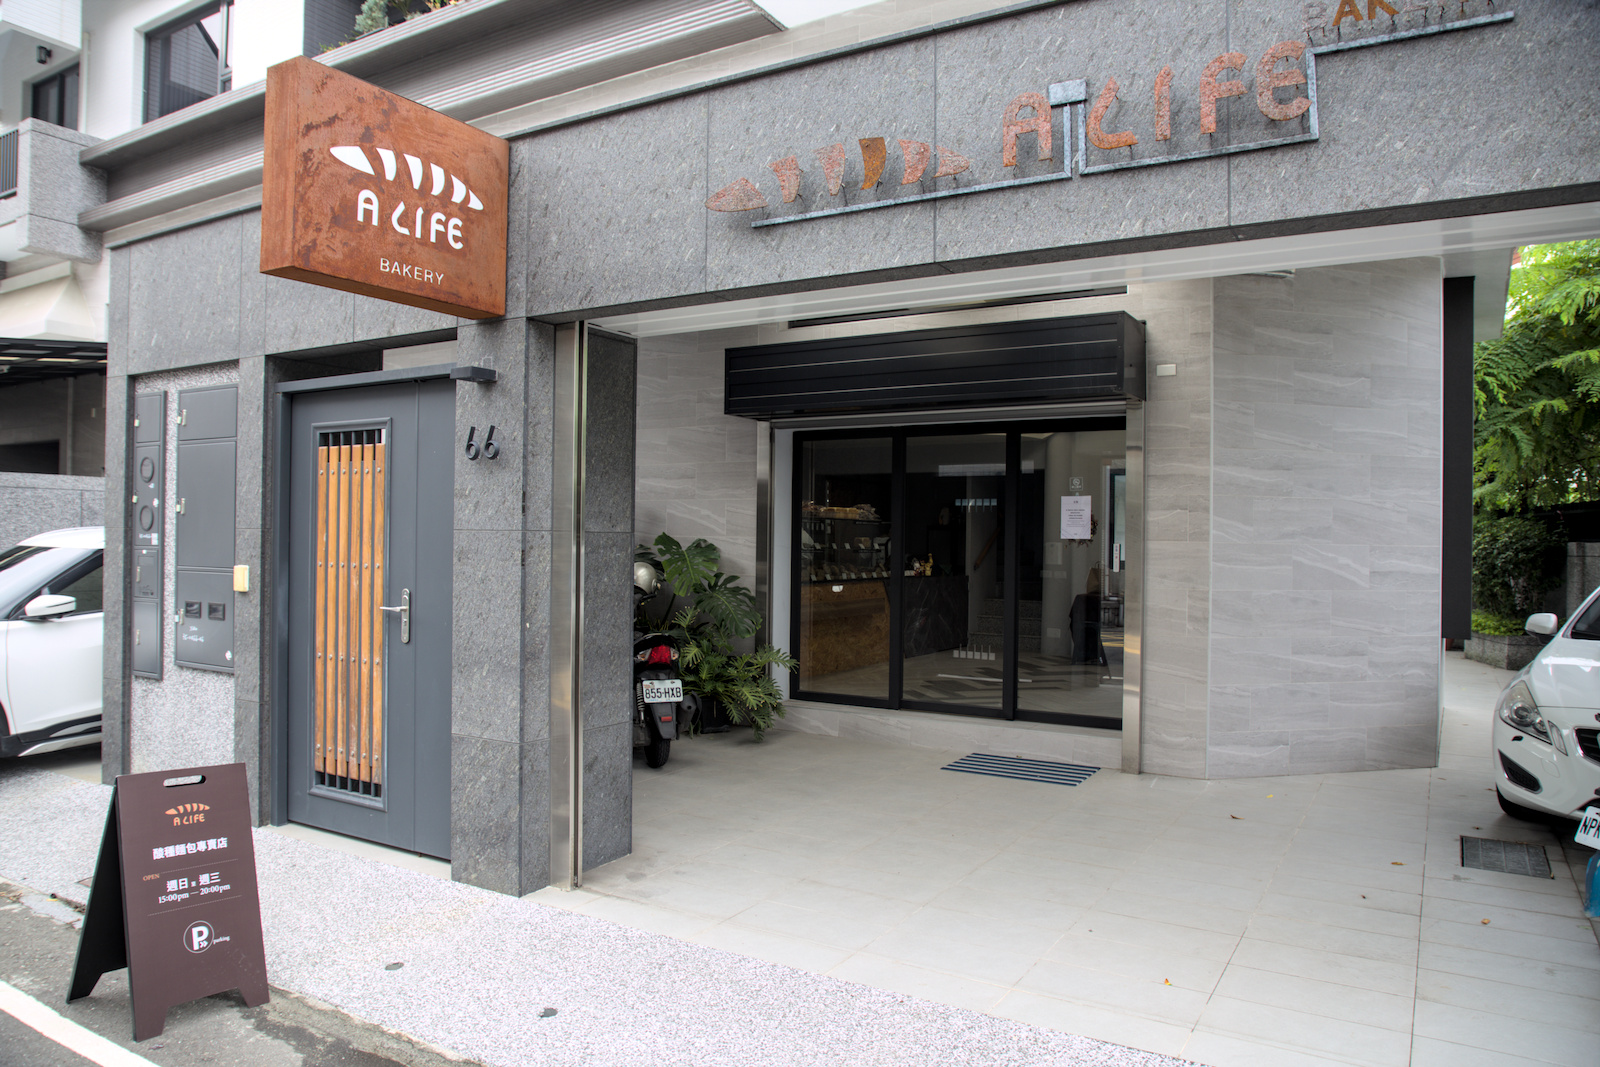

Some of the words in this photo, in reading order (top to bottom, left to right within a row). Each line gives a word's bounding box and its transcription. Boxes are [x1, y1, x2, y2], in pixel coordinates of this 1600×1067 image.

[1302, 0, 1496, 31] BAK
[1003, 91, 1052, 167] A
[1086, 40, 1312, 149] LIFE
[357, 189, 379, 226] A
[391, 201, 464, 250] LIFE
[380, 257, 444, 285] BAKERY
[465, 424, 500, 461] 66
[644, 687, 682, 699] 855-HXB
[173, 816, 181, 826] A
[182, 813, 205, 825] LIFE
[142, 873, 160, 881] OPEN
[158, 892, 189, 904] 15:00pm
[199, 884, 231, 895] 20:00pm
[212, 936, 231, 945] parking
